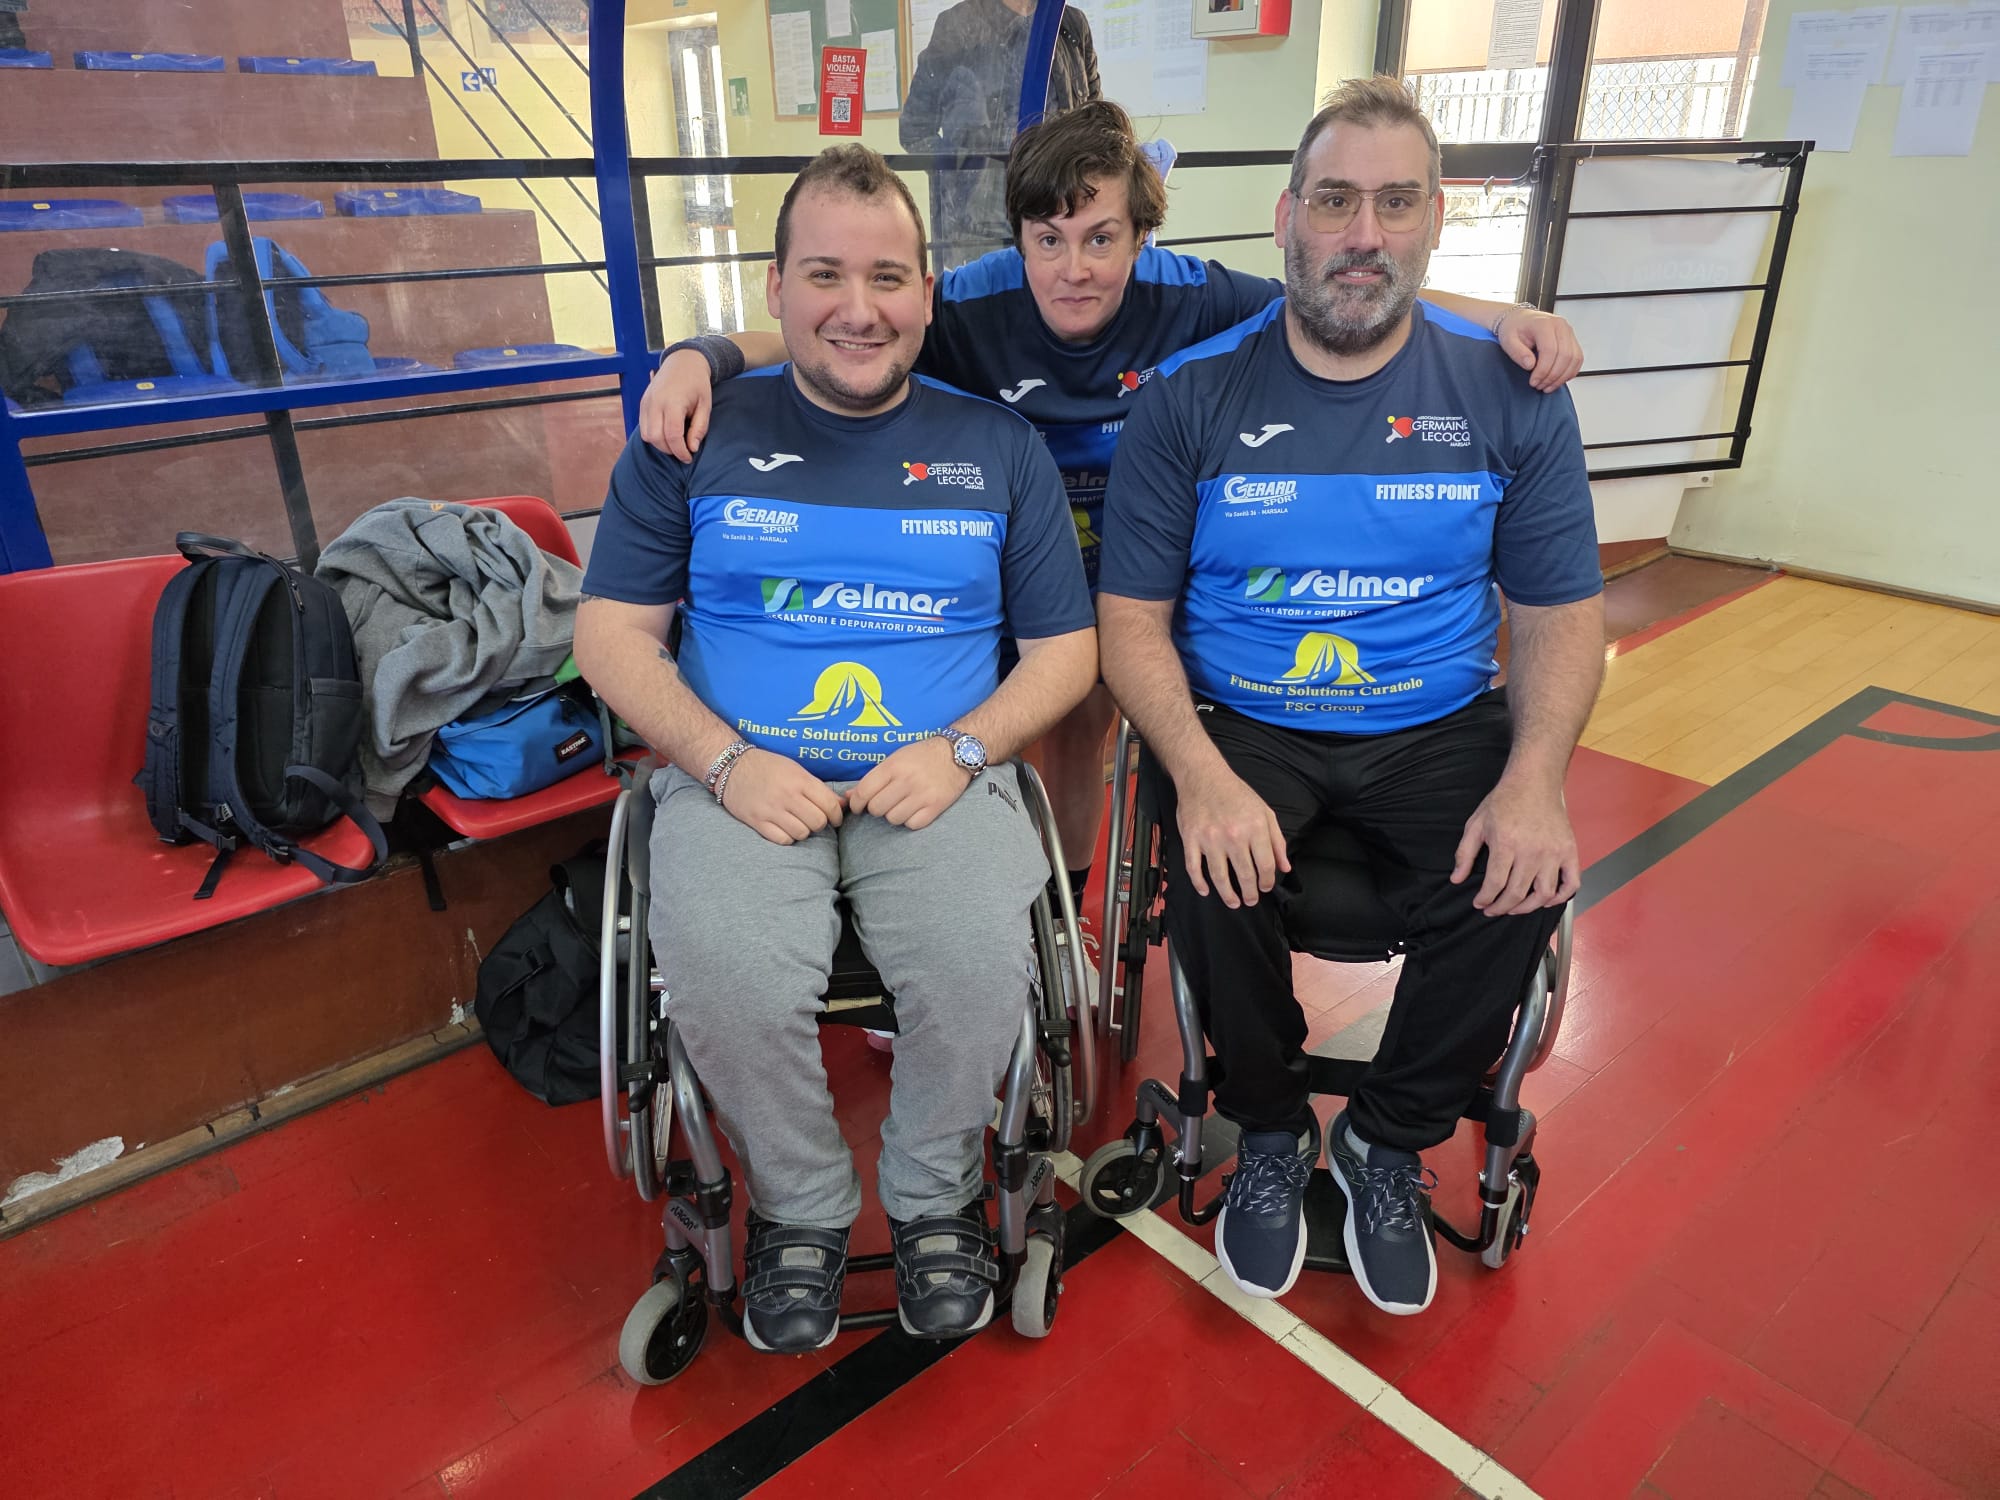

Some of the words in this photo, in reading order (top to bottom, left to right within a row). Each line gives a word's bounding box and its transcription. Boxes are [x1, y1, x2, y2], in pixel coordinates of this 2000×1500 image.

[832, 54, 856, 64] BASTA
[826, 63, 861, 73] VIOLENZA
[1412, 419, 1468, 431] GERMAINE
[1422, 431, 1471, 442] LECOCQ
[927, 467, 982, 476] GERMAINE
[937, 476, 984, 486] LECOCQ
[1224, 476, 1297, 500] GERARD
[1375, 484, 1435, 500] FITNESS
[1437, 484, 1481, 500] POINT
[1263, 493, 1298, 507] SPORT
[724, 499, 799, 526] GERARD
[762, 525, 800, 534] SPORT
[901, 519, 958, 535] FITNESS
[960, 520, 994, 537] POINT
[760, 535, 788, 543] MARSALA
[830, 617, 837, 625] E
[839, 619, 904, 632] DEPURATORI
[1229, 674, 1283, 696] Finance
[1287, 686, 1355, 697] Solutions
[1359, 678, 1424, 697] Curatolo
[1284, 702, 1316, 712] FSC
[1320, 704, 1365, 713] Group
[737, 718, 798, 738] Finance
[802, 727, 878, 743] Solutions
[799, 746, 833, 760] FSC
[838, 748, 887, 763] Group
